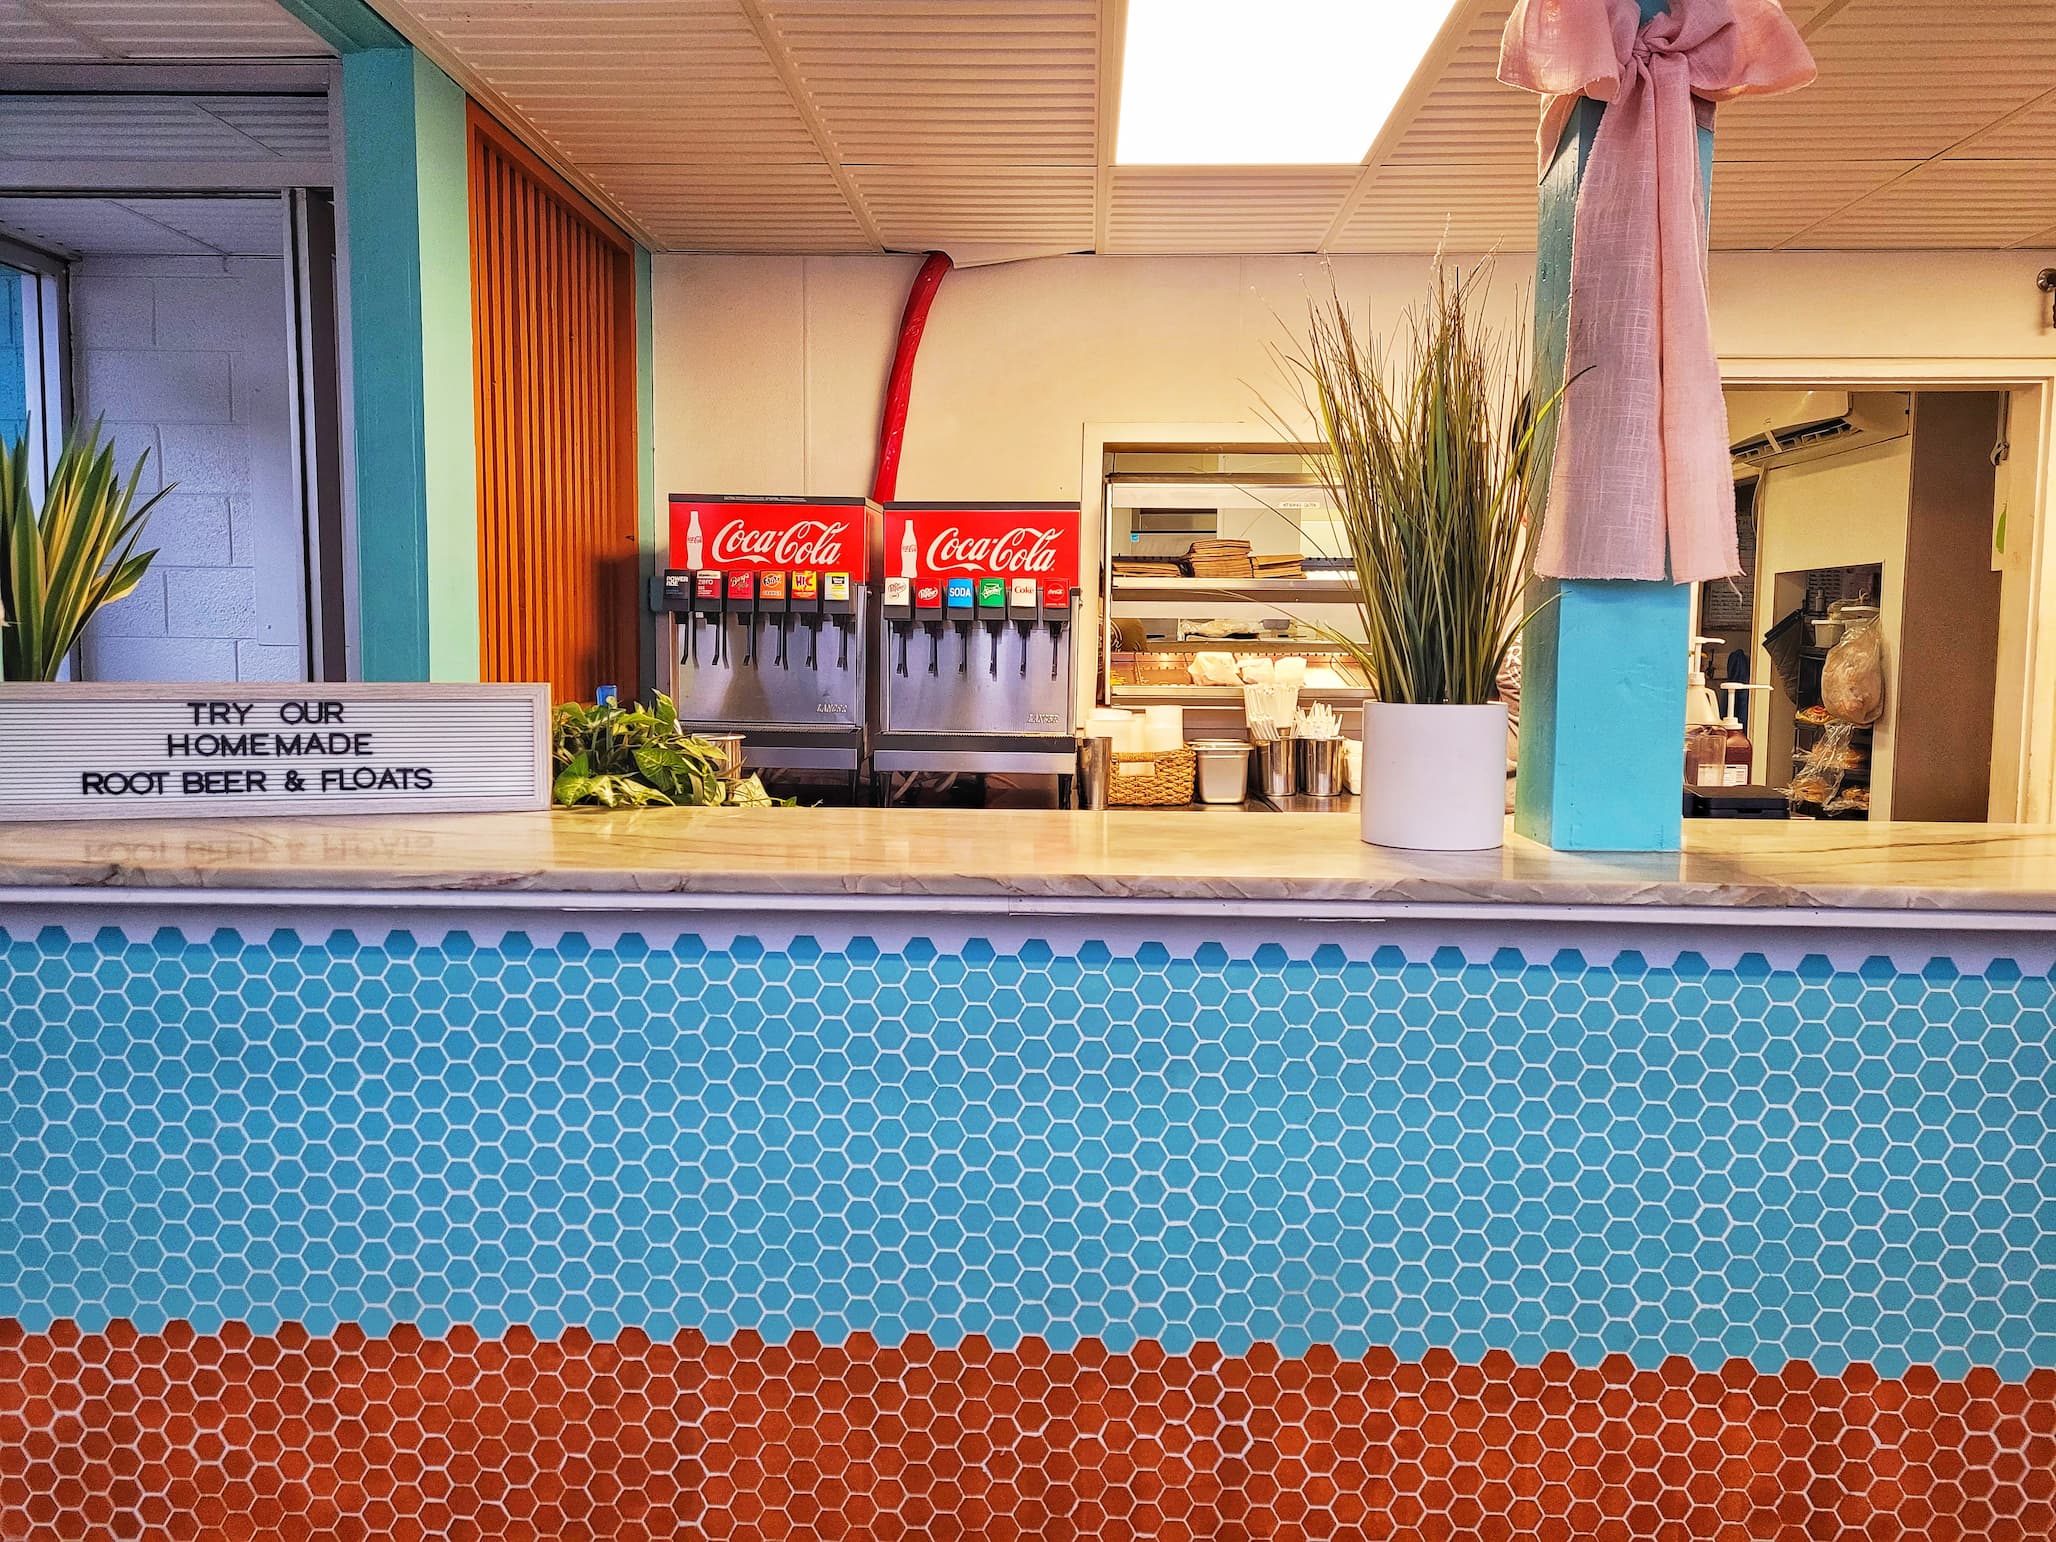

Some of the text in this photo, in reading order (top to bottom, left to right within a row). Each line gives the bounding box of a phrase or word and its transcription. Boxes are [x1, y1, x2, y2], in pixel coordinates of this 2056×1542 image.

[711, 519, 850, 565] Coca-Cola
[925, 527, 1065, 572] Coca-Cola
[949, 587, 971, 597] SODA
[1014, 585, 1034, 594] Coke
[187, 701, 345, 726] TRY OUR
[167, 732, 374, 758] HOMEMADE
[82, 767, 433, 795] ROOT BEER & FLOATS
